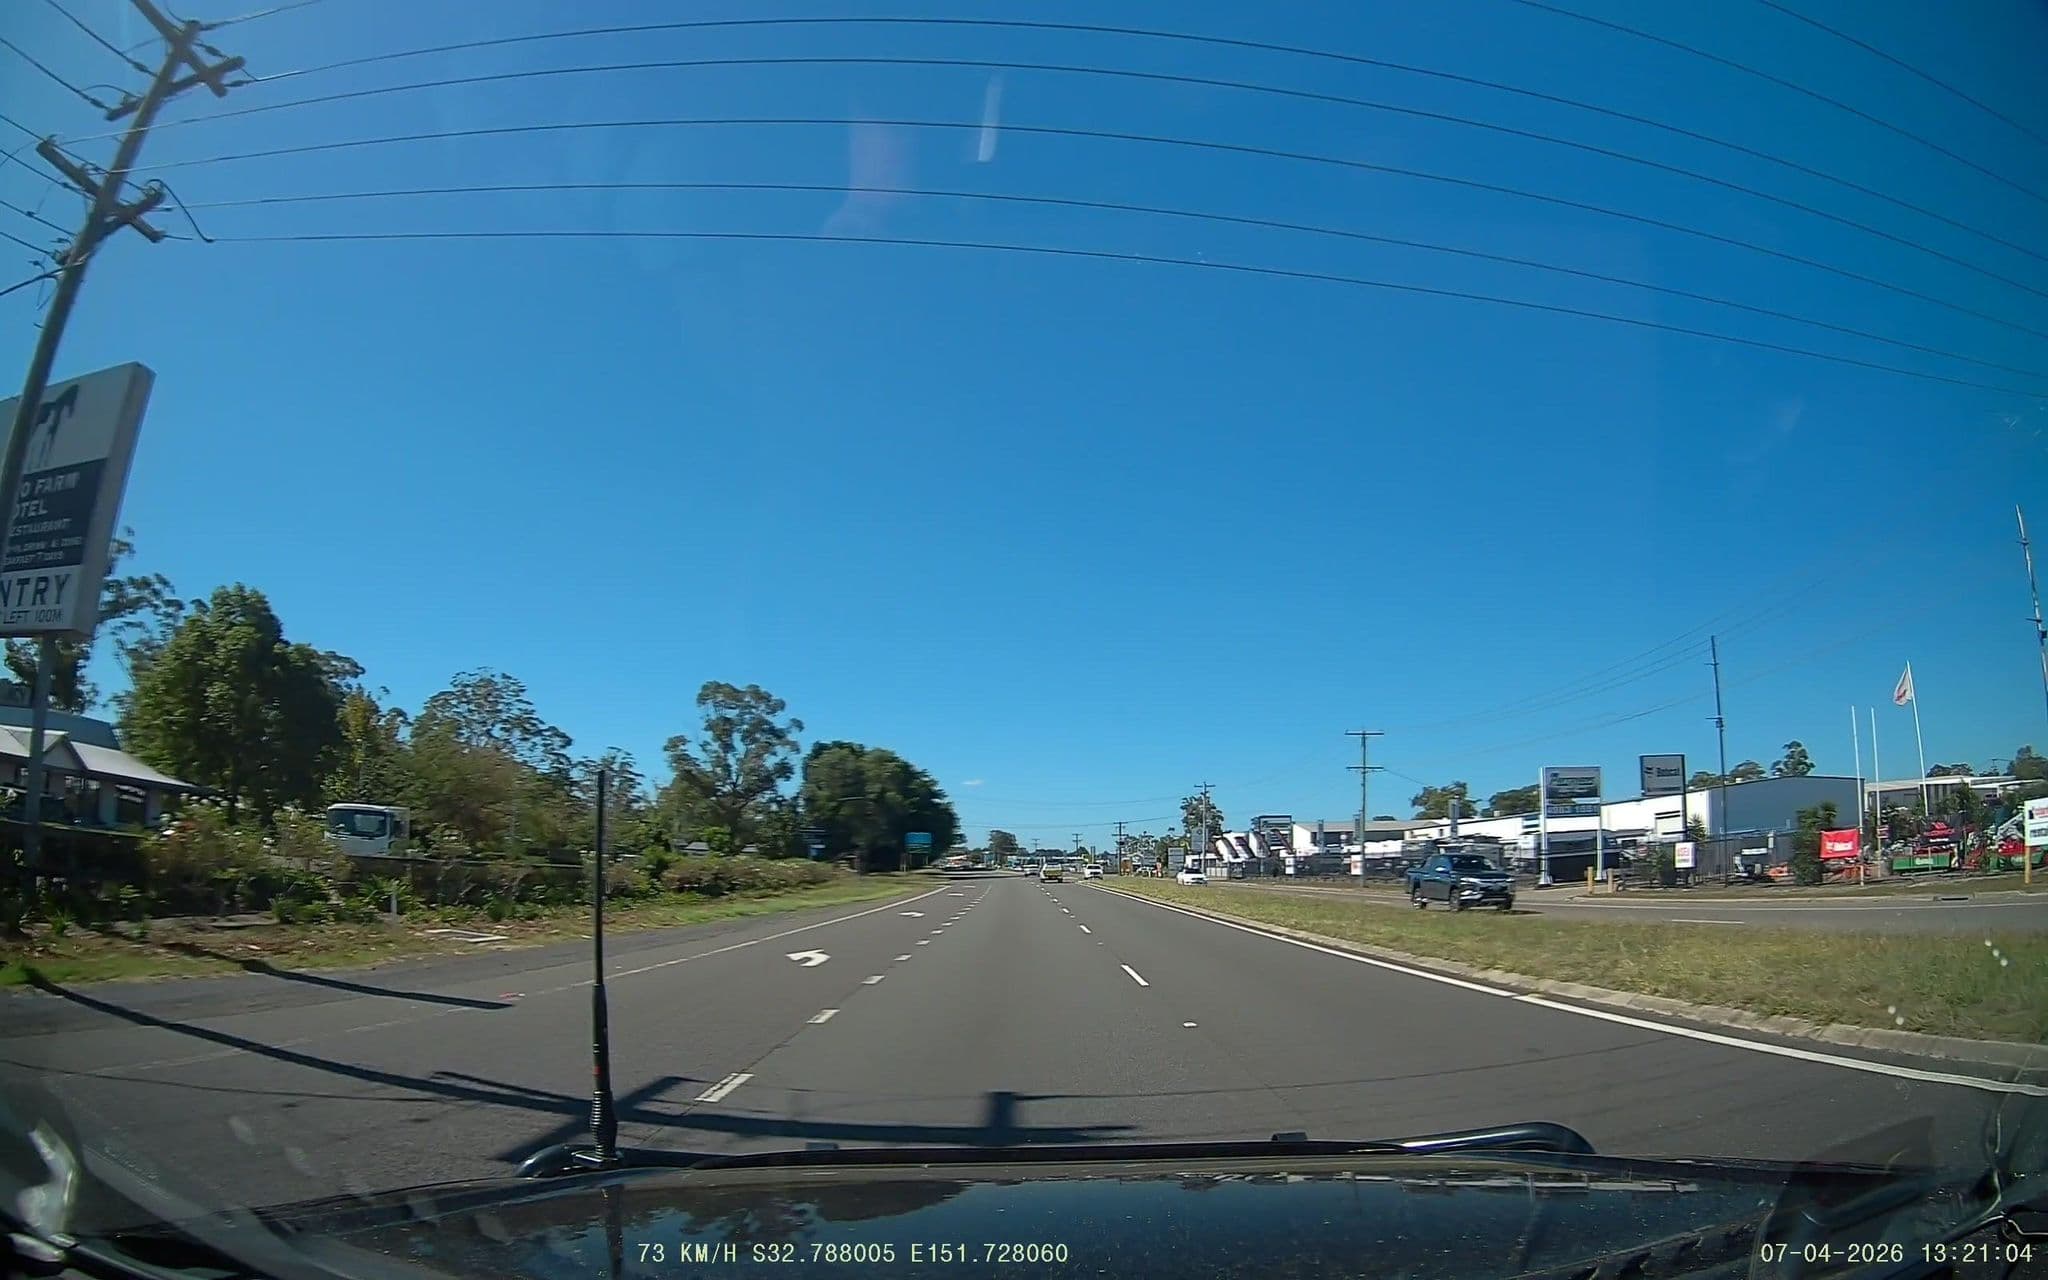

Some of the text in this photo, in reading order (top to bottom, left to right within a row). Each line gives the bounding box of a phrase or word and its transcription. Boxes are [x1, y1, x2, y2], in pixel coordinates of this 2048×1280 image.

[34, 472, 81, 496] FARM
[12, 499, 48, 521] OTEL
[0, 573, 72, 607] NTRY
[3, 610, 32, 625] LEFT
